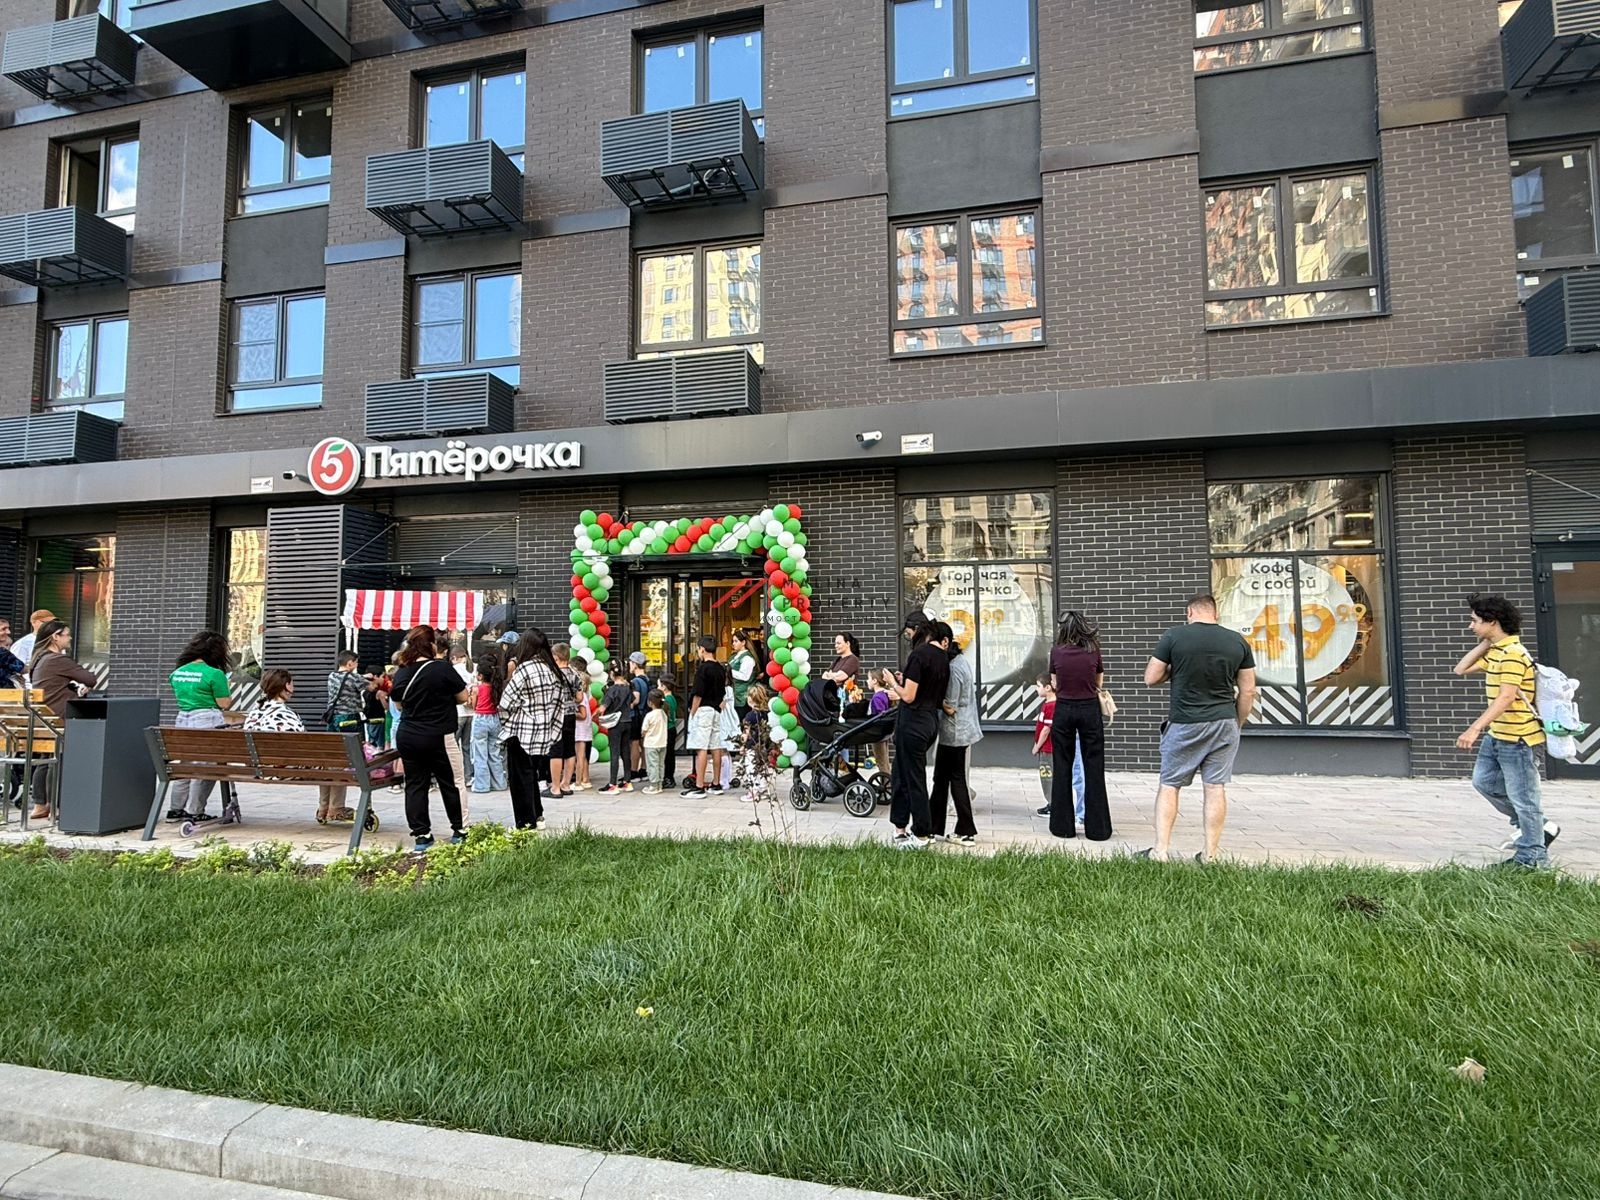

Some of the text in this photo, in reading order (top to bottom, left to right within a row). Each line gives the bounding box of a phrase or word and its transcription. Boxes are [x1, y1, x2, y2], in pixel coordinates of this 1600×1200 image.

[364, 440, 581, 481] Пятёрочка
[1250, 562, 1295, 576] Кофе
[947, 570, 1007, 583] Горчая
[1251, 576, 1316, 590] с собой
[947, 586, 1012, 596] выпечка
[1336, 603, 1367, 622] 99
